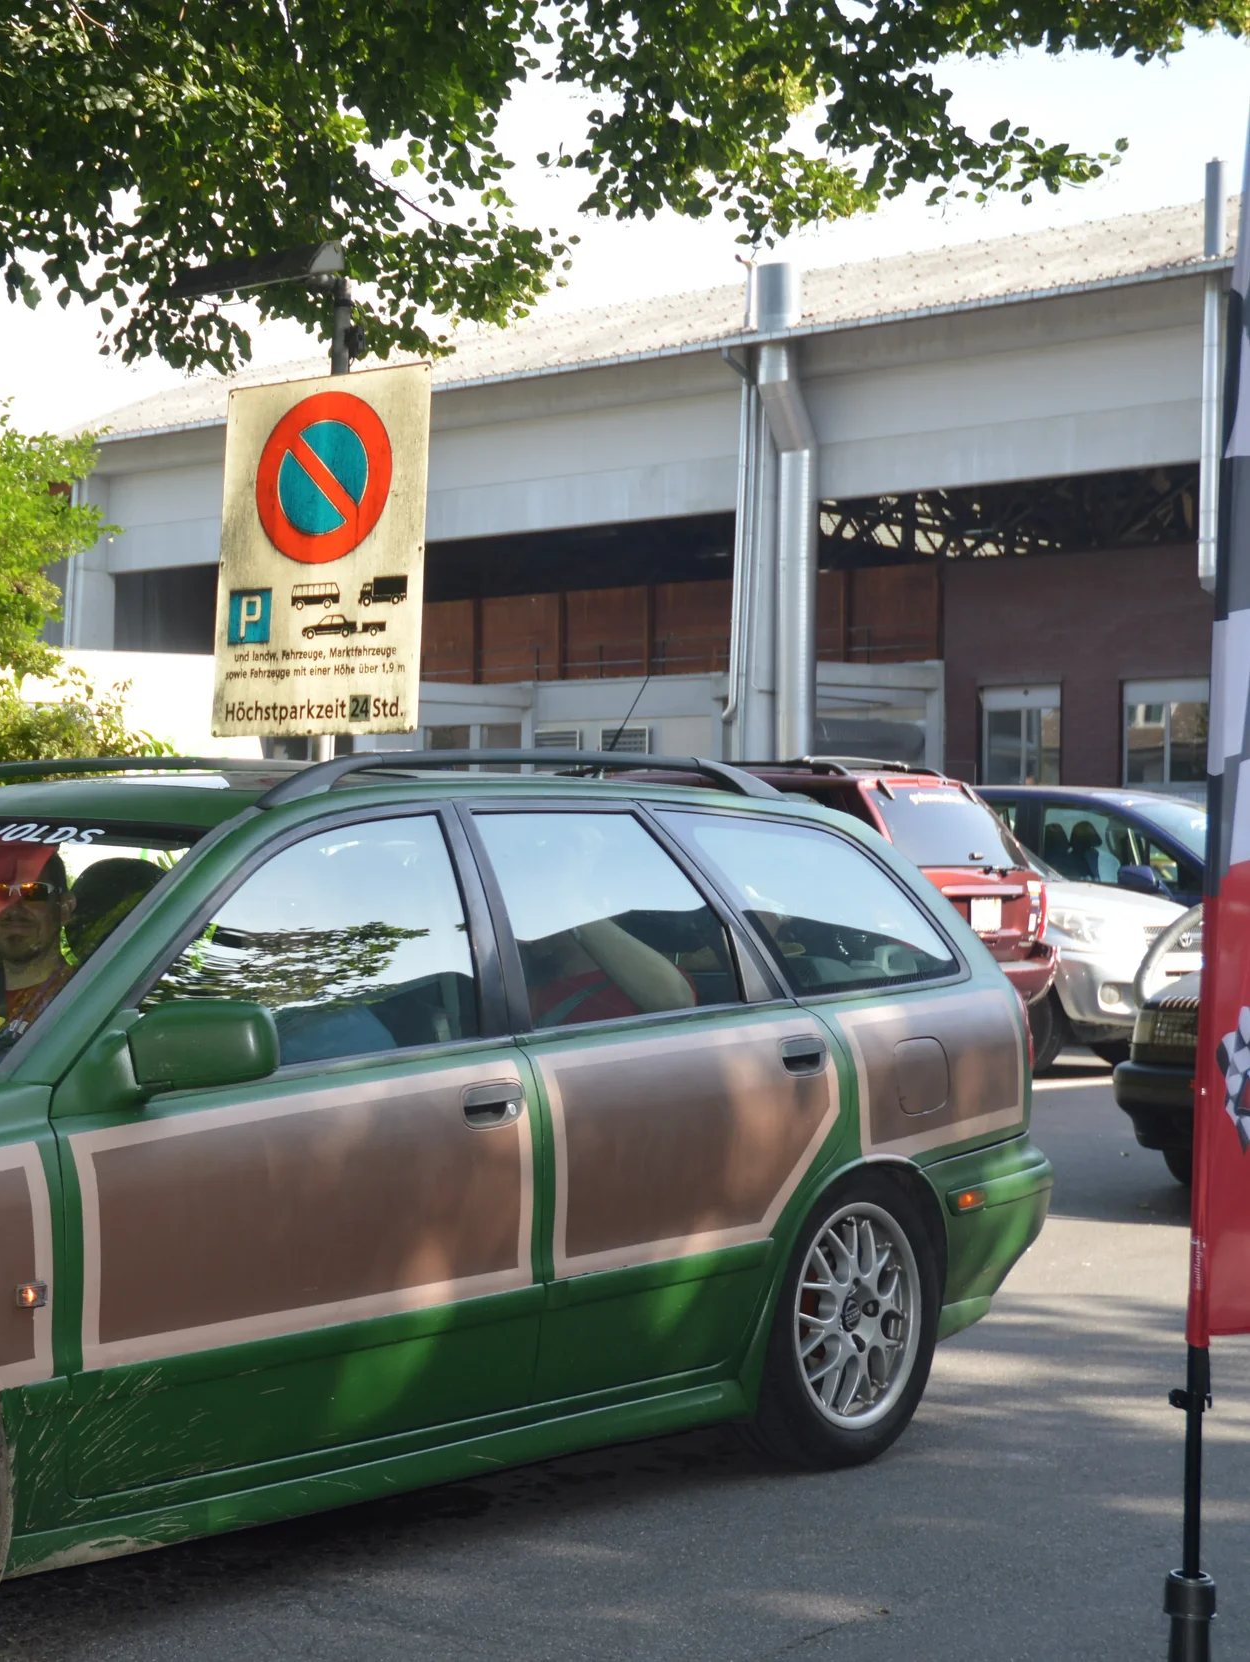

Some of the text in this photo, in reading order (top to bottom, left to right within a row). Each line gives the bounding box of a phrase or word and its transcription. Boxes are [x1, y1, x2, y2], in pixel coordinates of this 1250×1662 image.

[240, 595, 262, 638] P
[234, 645, 397, 663] und landw. Fahrzeuge, Marktfahrzeuge
[225, 662, 406, 680] sowie Fahrzeuge mit einer Höhe über 1,9 m
[225, 696, 404, 725] Höchstparkzeit 24 Std.
